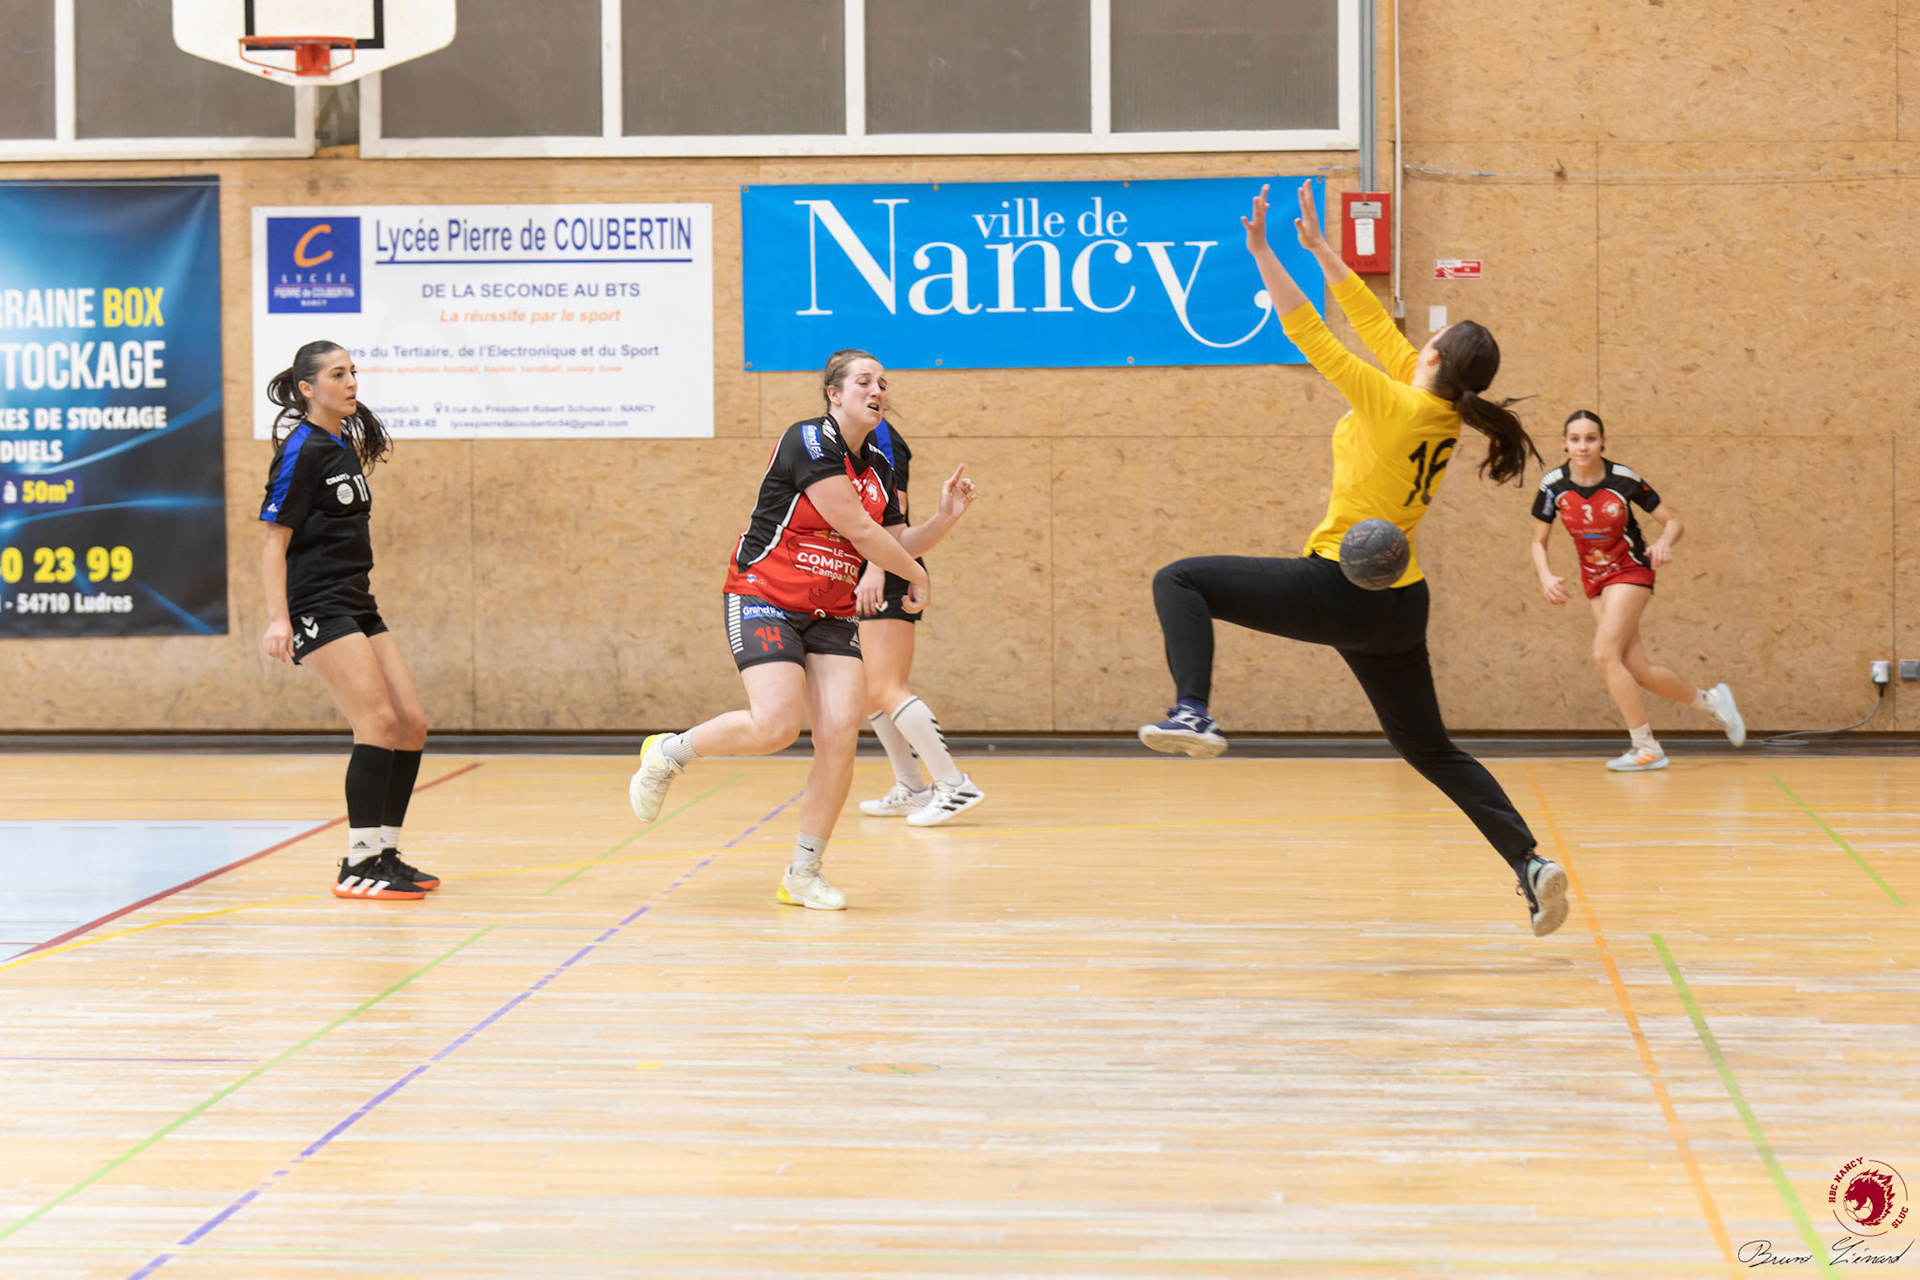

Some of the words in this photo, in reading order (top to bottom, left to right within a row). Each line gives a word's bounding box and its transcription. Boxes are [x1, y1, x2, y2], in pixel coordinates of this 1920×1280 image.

[972, 198, 1066, 239] ville
[1077, 197, 1128, 237] de
[376, 218, 439, 261] Lycée
[448, 218, 512, 251] Pierre
[521, 218, 546, 251] de
[554, 217, 691, 250] COUBERTIN
[794, 198, 1273, 348] Nancy
[422, 283, 446, 298] DE
[452, 283, 475, 298] LA
[481, 283, 568, 298] SECONDE
[574, 282, 599, 297] AU
[605, 282, 641, 297] BTS
[0, 288, 96, 328] RAINE
[103, 287, 165, 328] BOX
[440, 310, 458, 323] La
[463, 309, 526, 323] réussite
[531, 311, 557, 324] par
[561, 309, 575, 322] le
[579, 310, 621, 324] sport
[370, 346, 388, 357] du
[394, 346, 454, 358] Tertiaire,
[458, 345, 474, 356] de
[581, 345, 594, 356] et
[599, 345, 616, 356] du
[621, 345, 659, 358] Sport
[0, 340, 167, 390] TOCKAGE
[34, 407, 62, 430] DE
[67, 406, 167, 430] STOCKAGE
[0, 440, 63, 463] DUELS
[33, 546, 76, 583] 23
[86, 545, 133, 582] 99
[833, 548, 844, 558] LE
[16, 592, 71, 614] 54710
[74, 592, 133, 613] Ludres
[753, 626, 784, 652] 14
